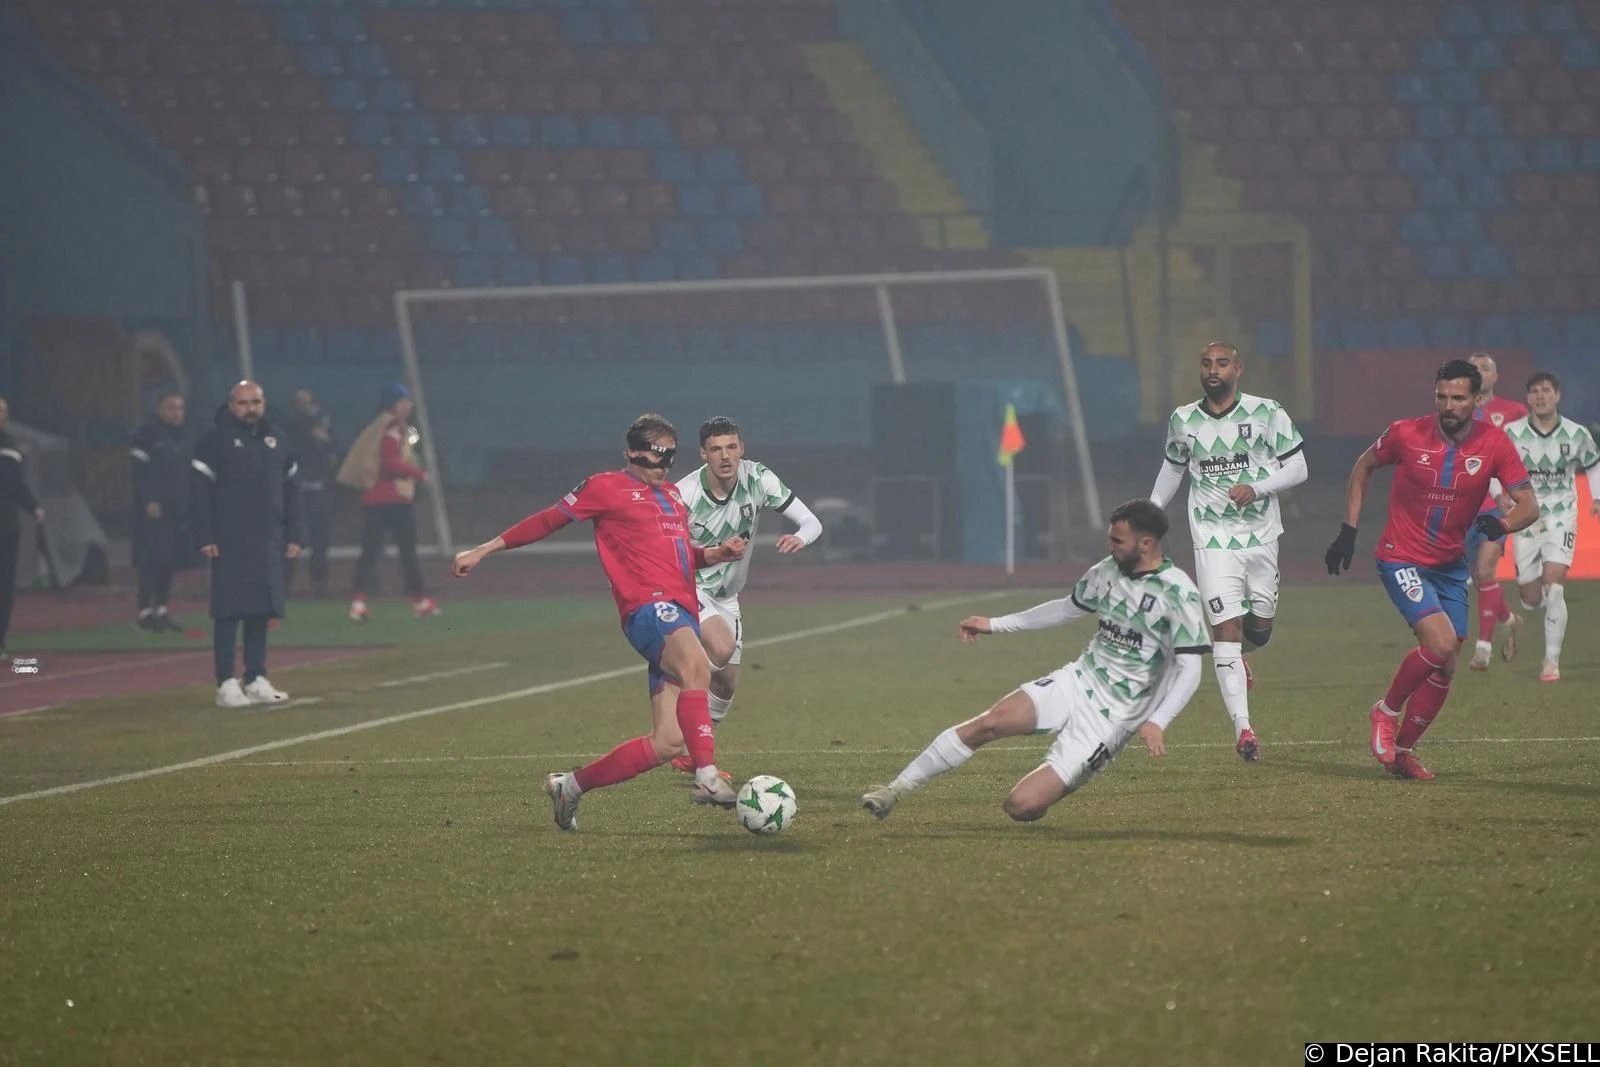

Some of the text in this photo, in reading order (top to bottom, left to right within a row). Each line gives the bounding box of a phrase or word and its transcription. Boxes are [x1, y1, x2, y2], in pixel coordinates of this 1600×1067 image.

[1201, 461, 1248, 473] LJUBLJANA
[1563, 531, 1575, 550] 18
[1394, 567, 1423, 592] 99
